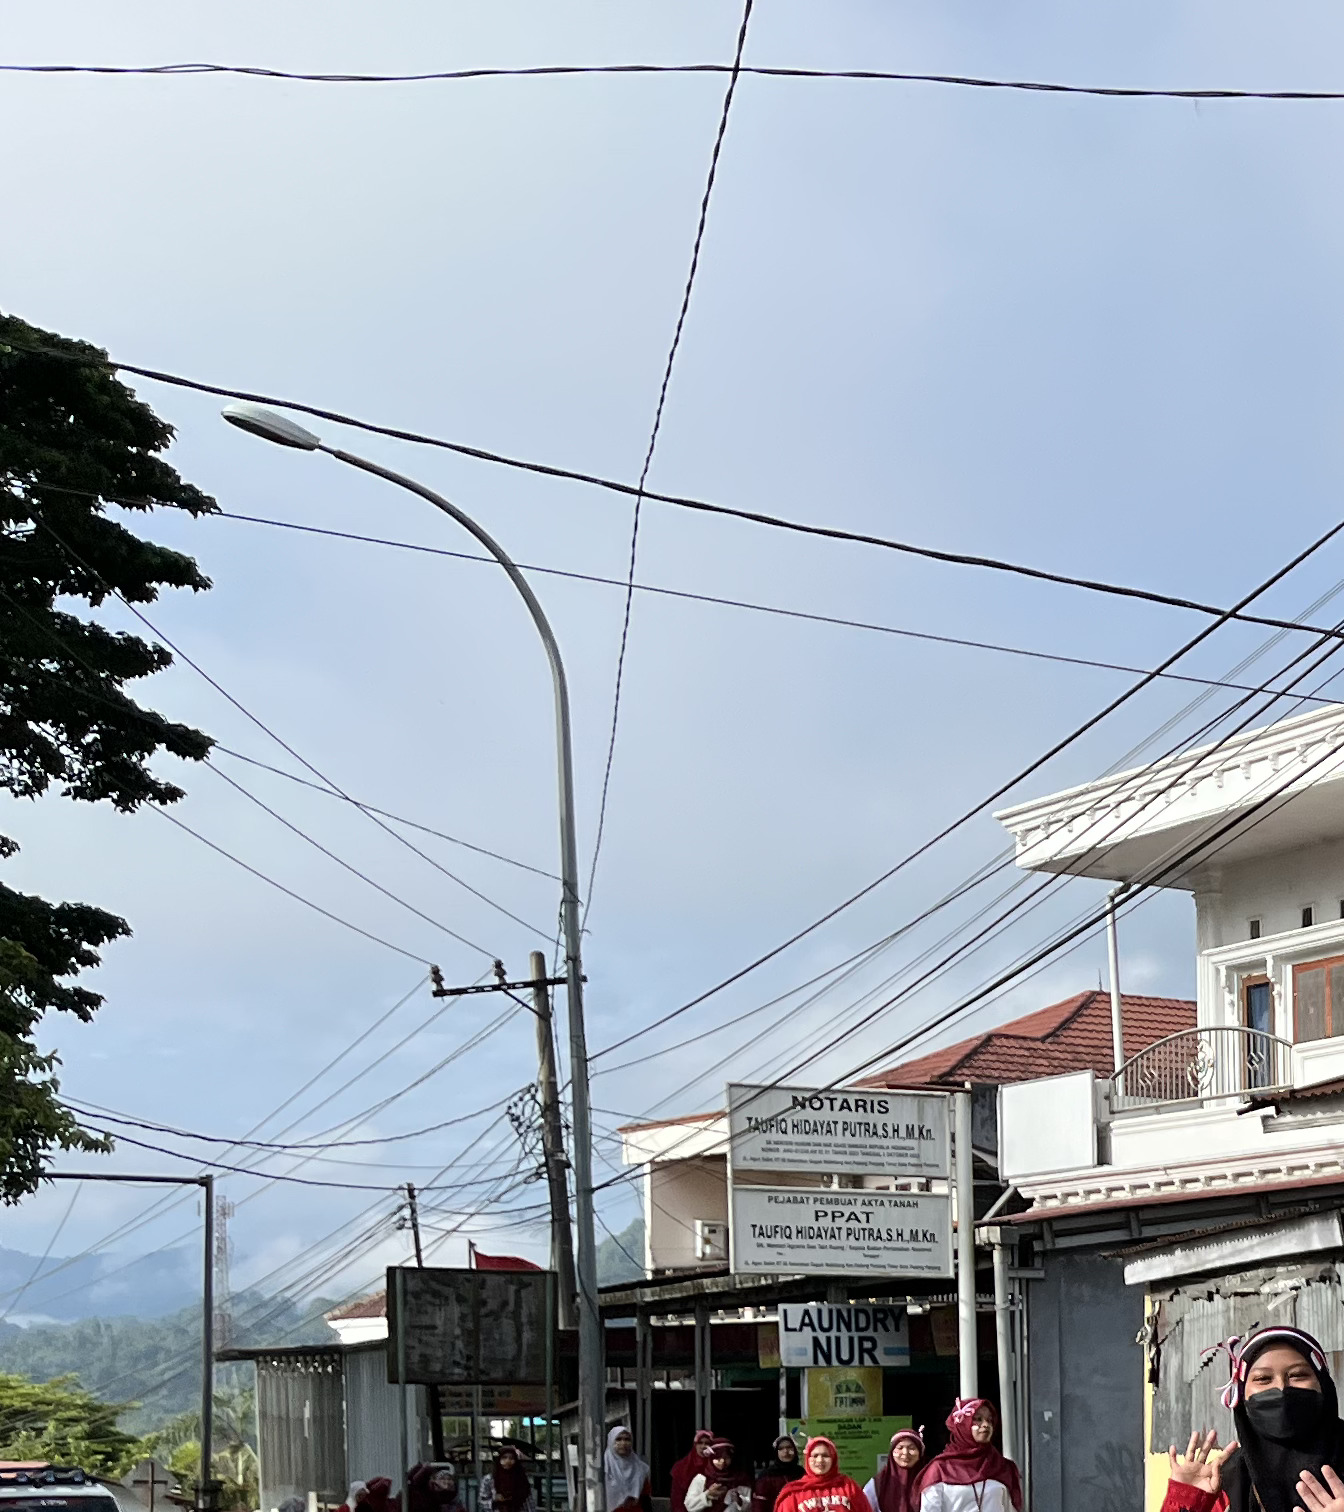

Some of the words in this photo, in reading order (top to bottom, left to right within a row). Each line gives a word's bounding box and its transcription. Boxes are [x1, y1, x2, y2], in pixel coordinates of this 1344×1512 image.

[791, 1095, 890, 1115] NOTARIS
[746, 1116, 788, 1135] TAUFIQ
[791, 1118, 839, 1137] HIDAYAT
[767, 1195, 811, 1205] PEJABAT
[813, 1196, 858, 1207] PEMBUAT
[860, 1198, 886, 1208] AKTA
[887, 1199, 919, 1209] TANAH
[814, 1209, 875, 1224] PPAT
[750, 1223, 793, 1240] TAUFIQ
[796, 1225, 843, 1241] HIDAYAT
[783, 1307, 905, 1333] LAUNDRY
[811, 1335, 880, 1366] NUR
